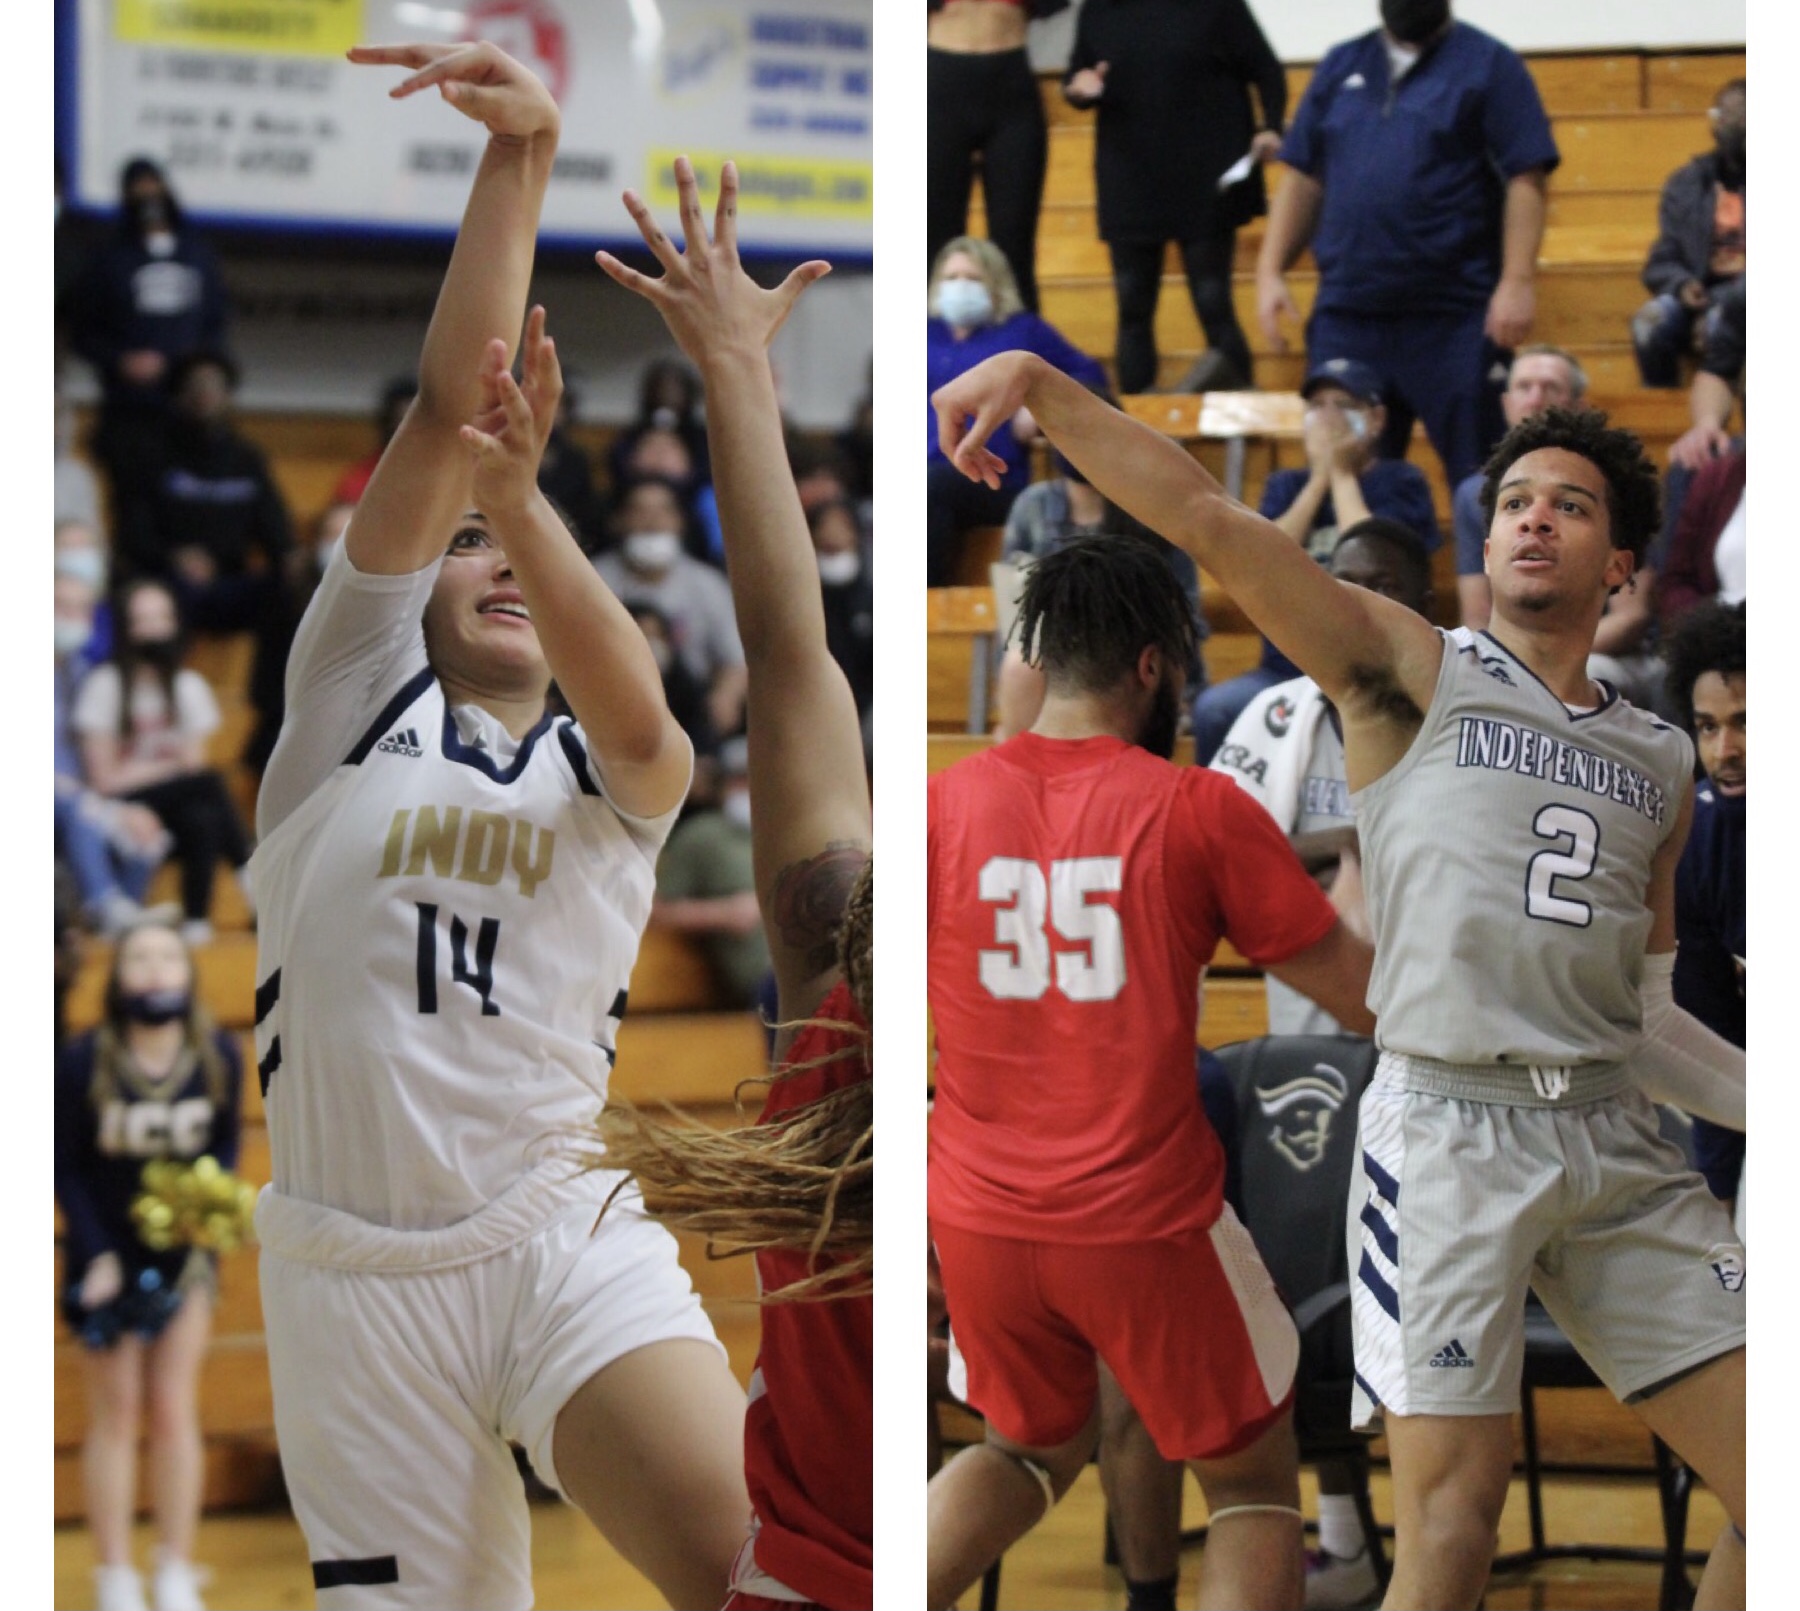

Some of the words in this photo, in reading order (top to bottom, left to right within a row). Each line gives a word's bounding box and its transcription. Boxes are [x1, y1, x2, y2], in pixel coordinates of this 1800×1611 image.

[378, 742, 423, 757] adidas
[376, 805, 556, 899] INDY
[1525, 803, 1600, 928] 2
[415, 902, 500, 1016] 14
[978, 856, 1127, 1001] 35
[1430, 1356, 1474, 1367] adidas
